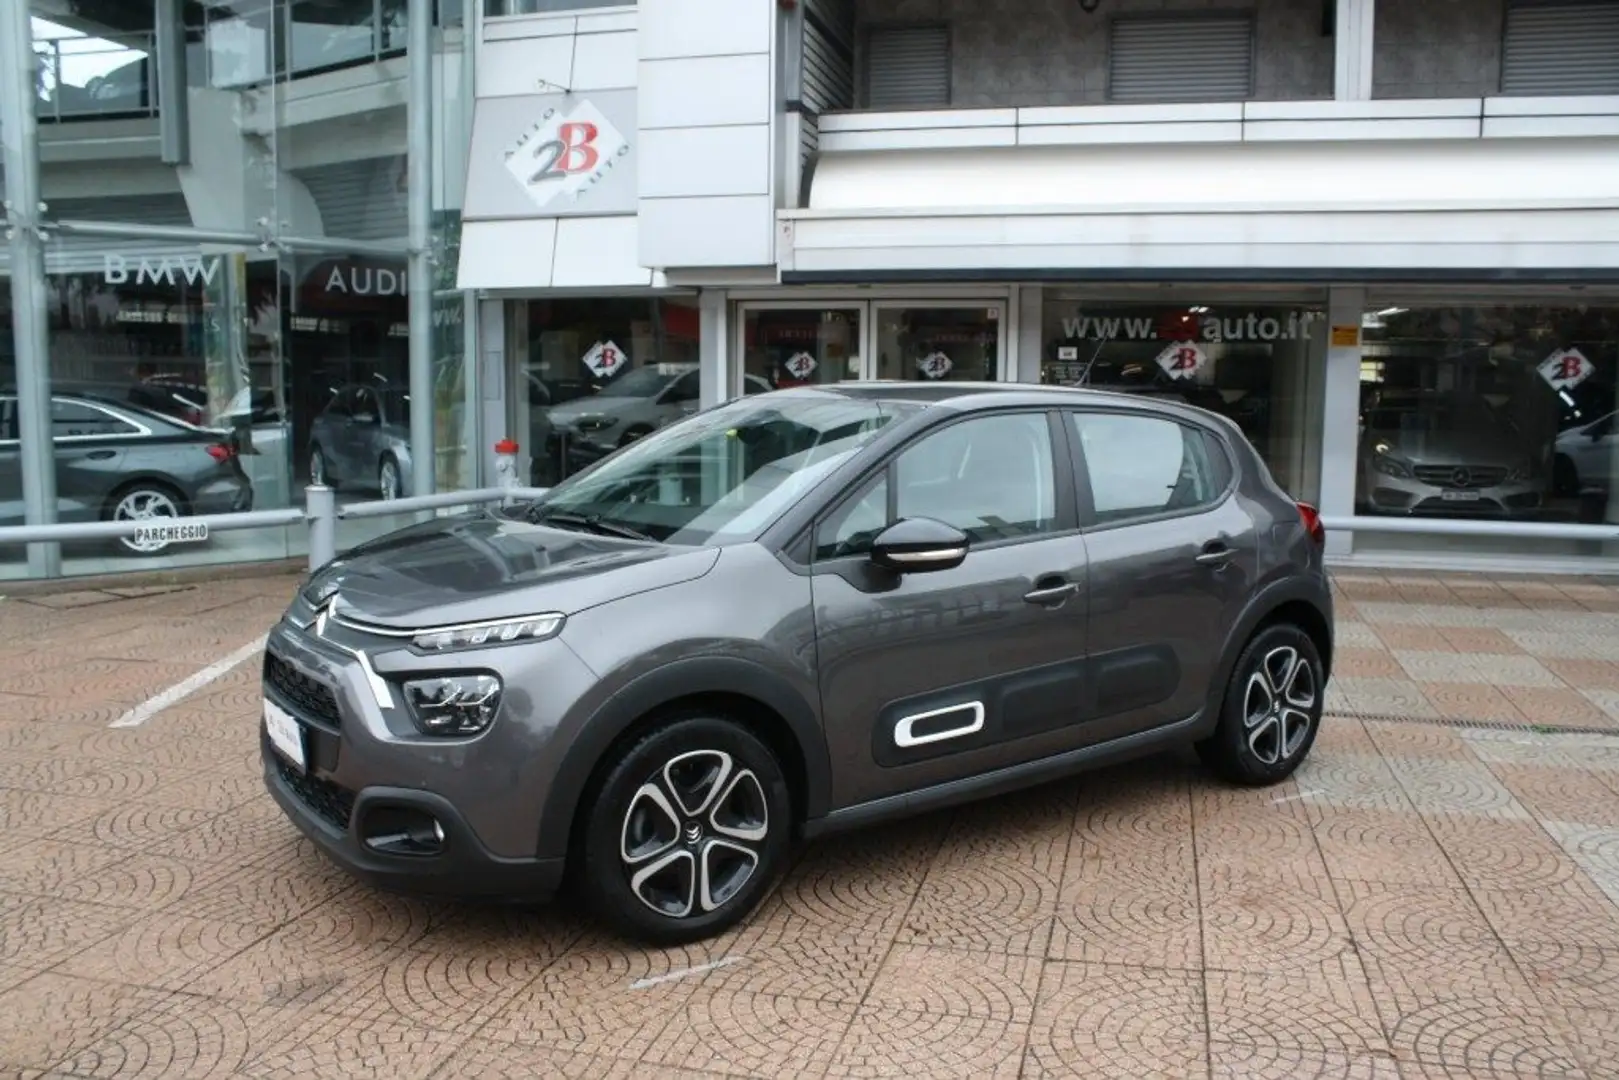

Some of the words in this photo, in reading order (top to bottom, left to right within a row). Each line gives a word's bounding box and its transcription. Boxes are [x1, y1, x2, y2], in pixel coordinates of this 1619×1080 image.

[527, 121, 599, 185] 2B
[104, 253, 219, 286] BMW
[325, 264, 406, 297] AUDI
[1169, 347, 1197, 371] 2B
[1551, 355, 1582, 380] 2B
[135, 524, 207, 543] PARCHEGGIO
